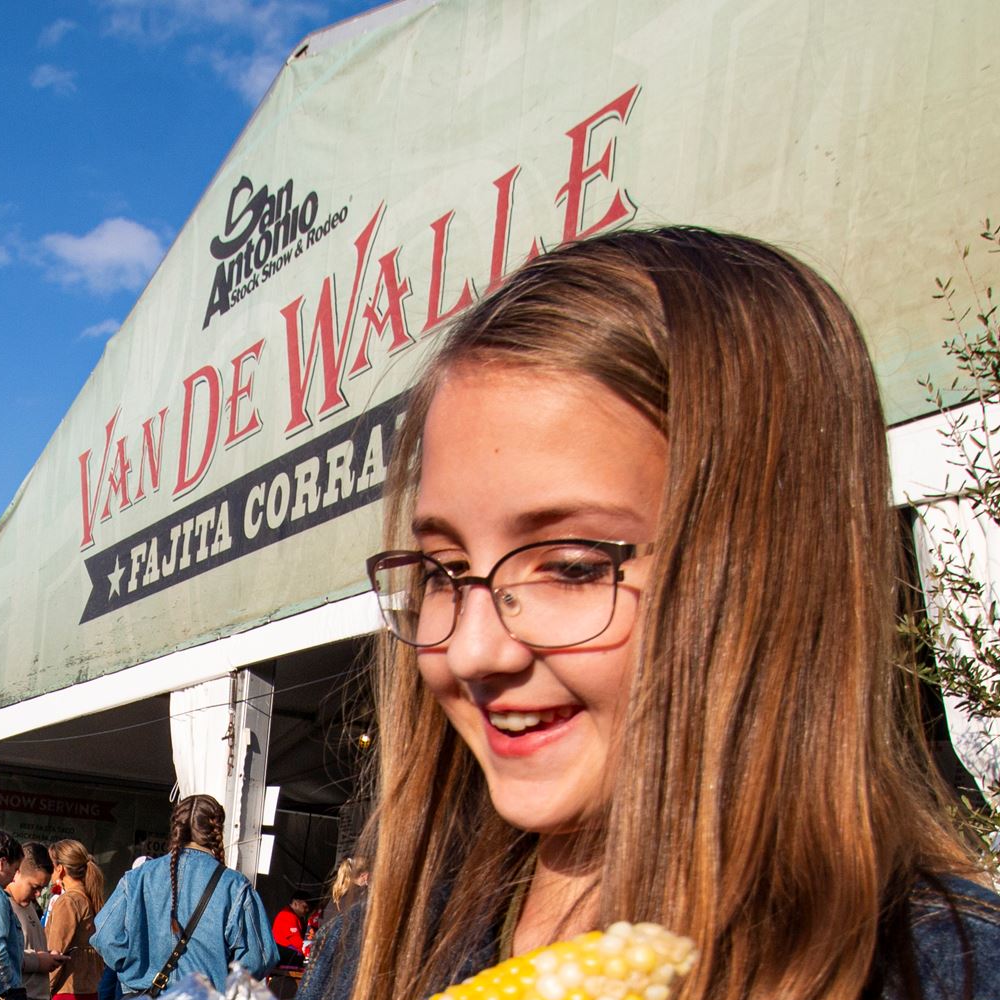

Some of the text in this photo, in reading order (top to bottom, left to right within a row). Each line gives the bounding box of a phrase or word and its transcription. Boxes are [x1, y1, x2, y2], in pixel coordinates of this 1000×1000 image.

[202, 190, 319, 331] Antonio
[210, 175, 294, 260] San
[230, 205, 348, 308] Stock Show & Rodeo
[279, 83, 643, 441] WALLE
[127, 410, 421, 594] FAJITA CORRA
[39, 798, 100, 816] SERVING
